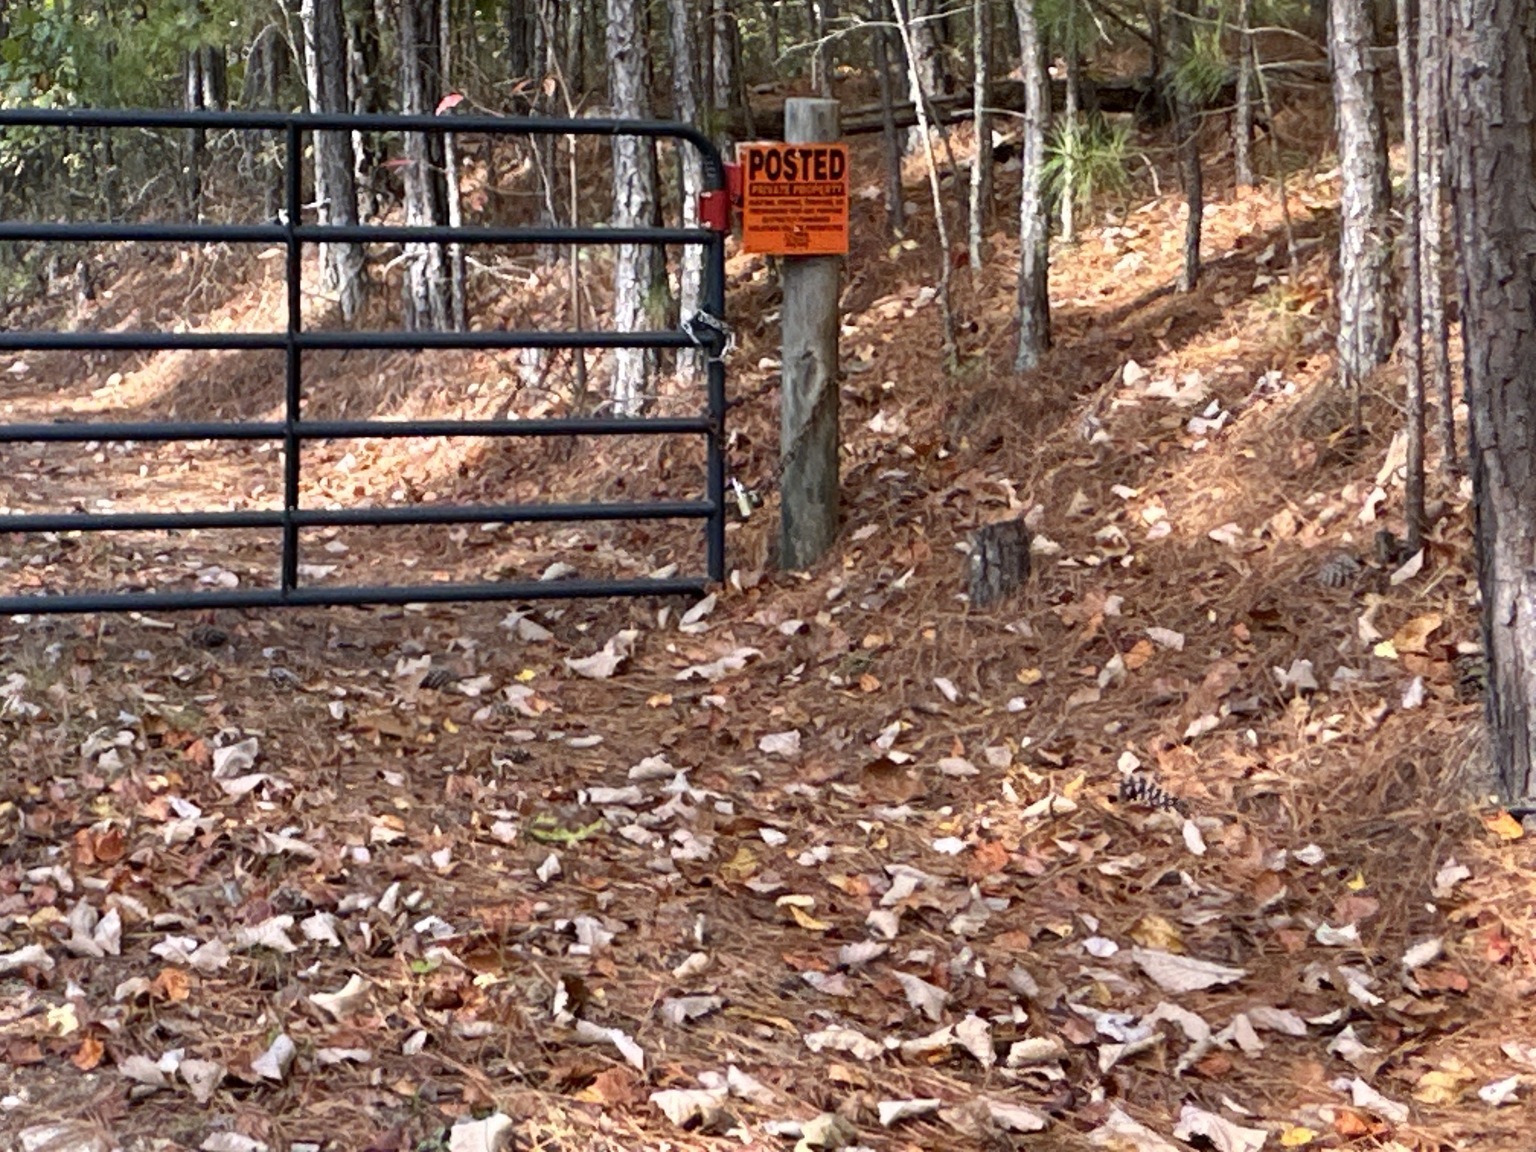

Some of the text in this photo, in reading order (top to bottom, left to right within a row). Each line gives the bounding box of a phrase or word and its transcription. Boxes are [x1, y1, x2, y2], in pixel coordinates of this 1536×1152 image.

[748, 148, 845, 181] POSTED
[751, 184, 843, 195] PRIVATE PROPERTY
